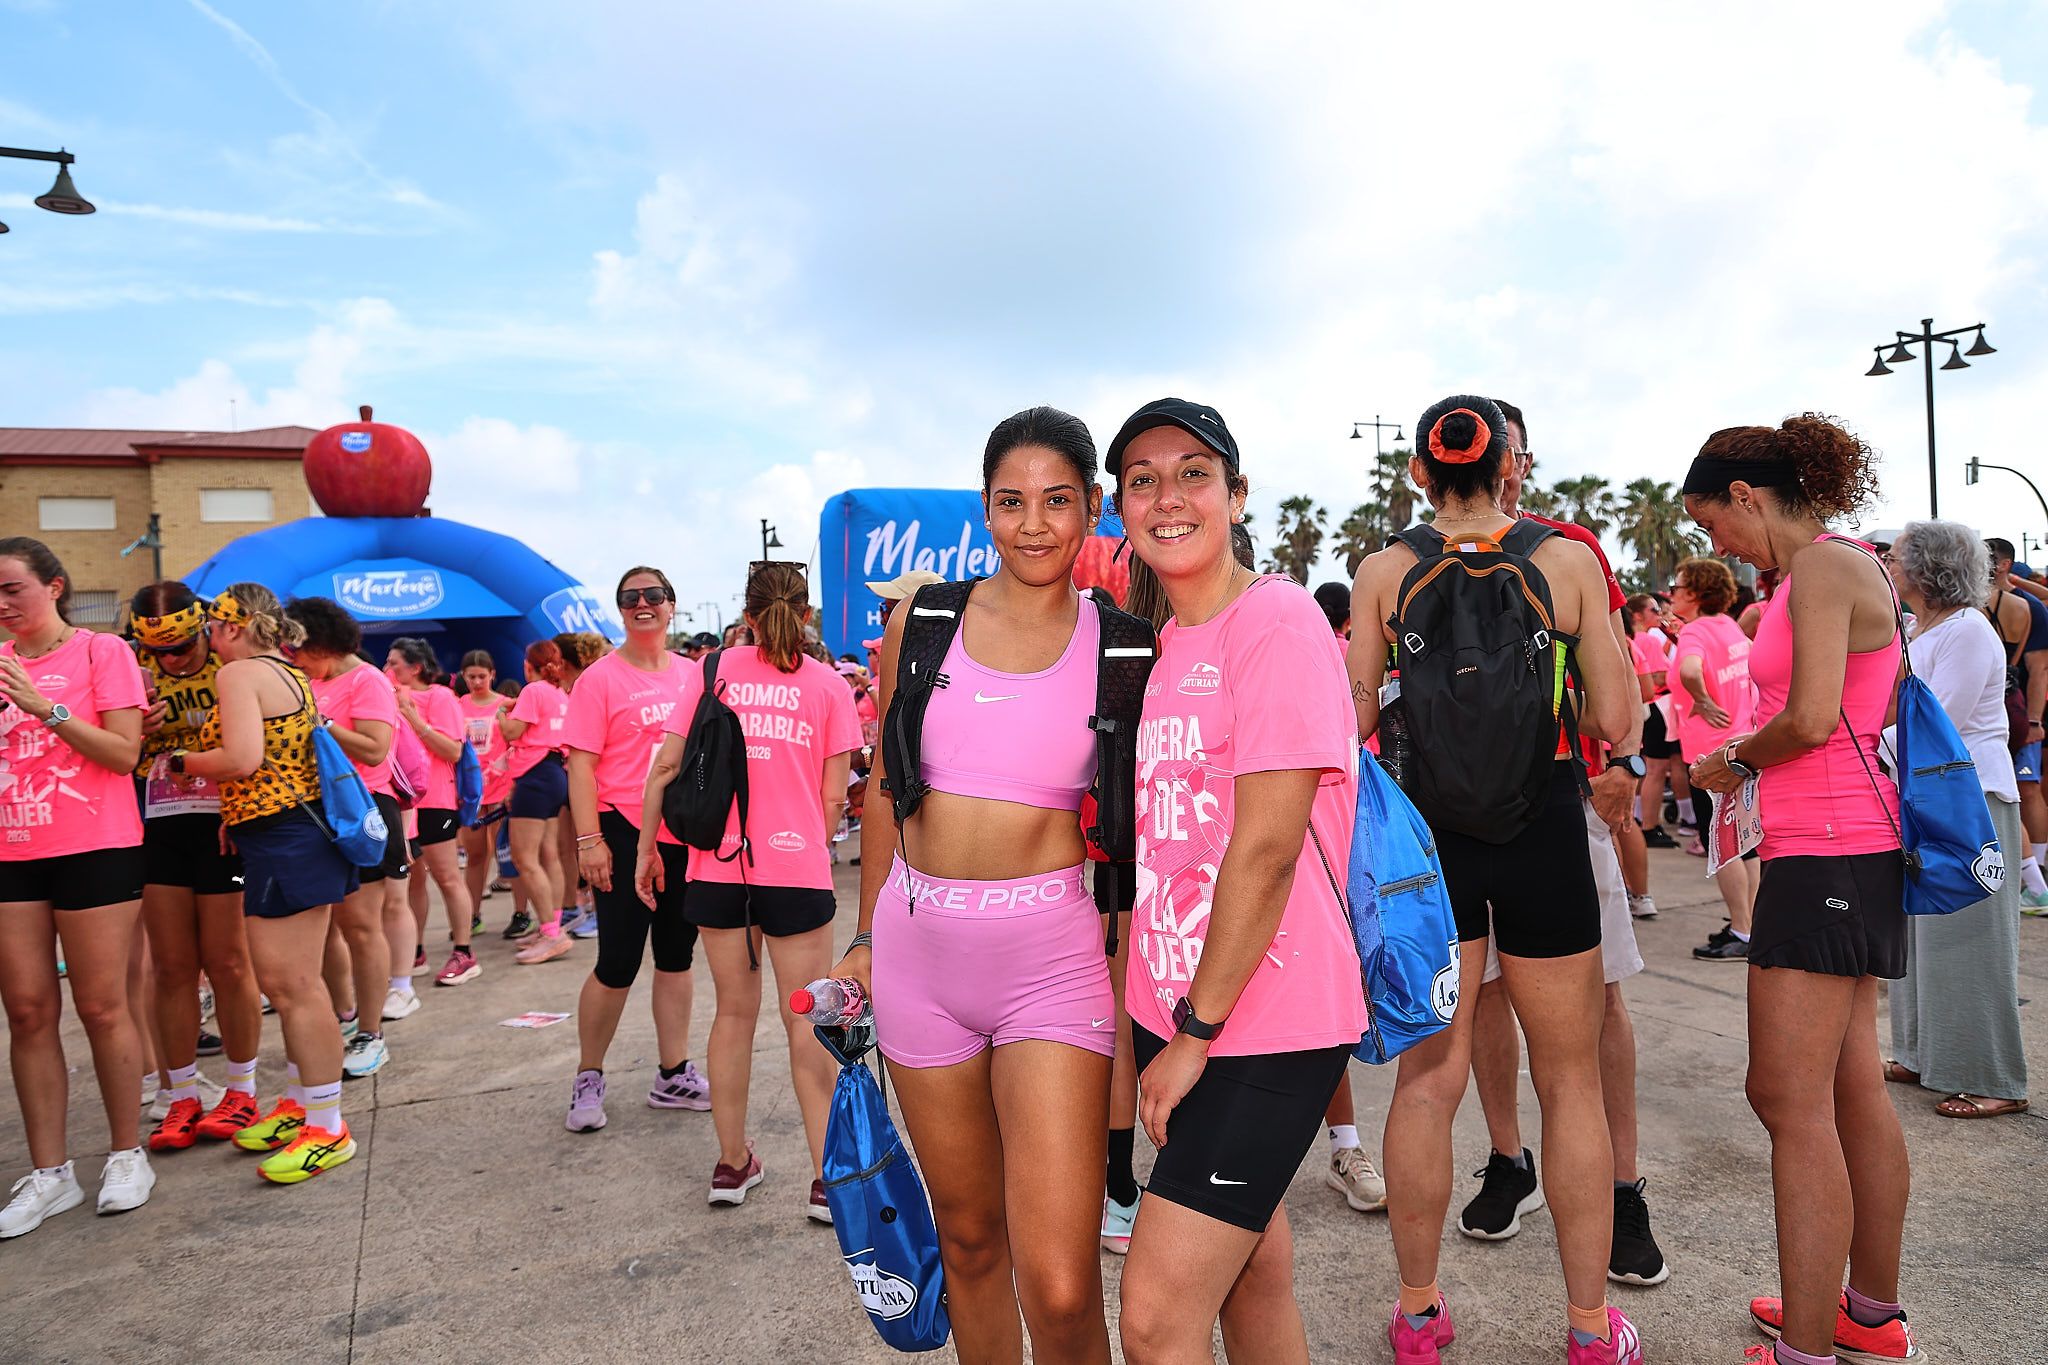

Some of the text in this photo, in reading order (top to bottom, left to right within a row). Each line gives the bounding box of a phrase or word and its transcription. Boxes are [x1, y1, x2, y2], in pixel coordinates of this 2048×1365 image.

[727, 682, 801, 711] SOMOS
[18, 727, 46, 760] DE
[745, 744, 772, 761] 2026
[0, 801, 54, 828] UJER
[1153, 777, 1189, 841] DE
[894, 870, 973, 911] NIKE
[977, 878, 1067, 911] PRO
[1150, 874, 1179, 934] LA
